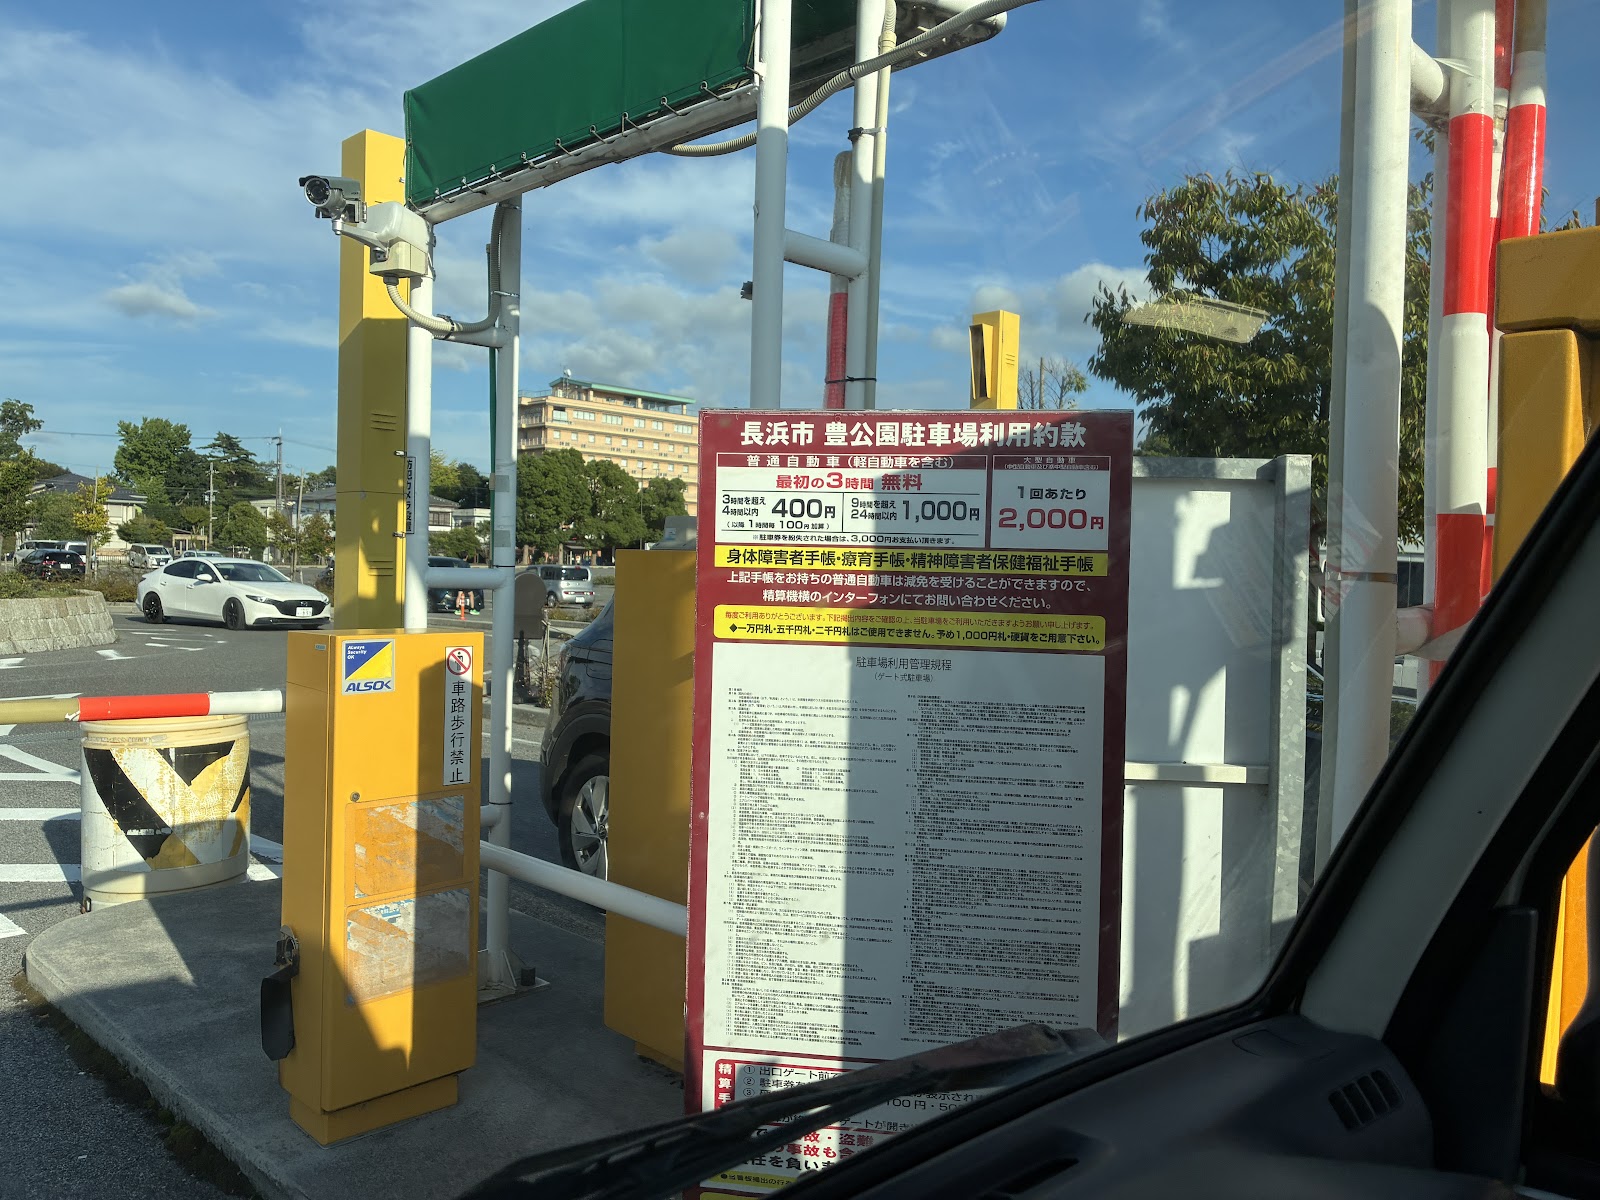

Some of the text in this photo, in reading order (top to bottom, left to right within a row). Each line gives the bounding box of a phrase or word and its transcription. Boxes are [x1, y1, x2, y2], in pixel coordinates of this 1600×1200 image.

[740, 421, 1087, 448] 長浜市 豊公園駐車場利用約款
[776, 472, 922, 491] 最初の3時間 無料
[722, 494, 766, 505] 3時間を超え
[1018, 486, 1086, 500] 1回あたり
[722, 508, 759, 517] 4時間以内
[771, 499, 836, 518] 400円
[851, 498, 896, 509] 9時間を超え
[903, 500, 980, 523] 1,000円
[851, 509, 898, 521] 24時間以内
[998, 508, 1104, 532] 2,000円
[727, 548, 1093, 573] 身体障害者手帳・療育手帳・精神障害者保健福祉手帳
[727, 571, 1092, 593] 上記手帳をお持ちの普通自動車は減免を受けることができますので、
[763, 589, 1051, 610] 精算機横のインターフォンにてお問い合わせください。
[856, 656, 952, 671] 駐車場利用管理規程
[345, 680, 392, 693] ALSOK
[449, 680, 466, 783] 車路歩行禁止
